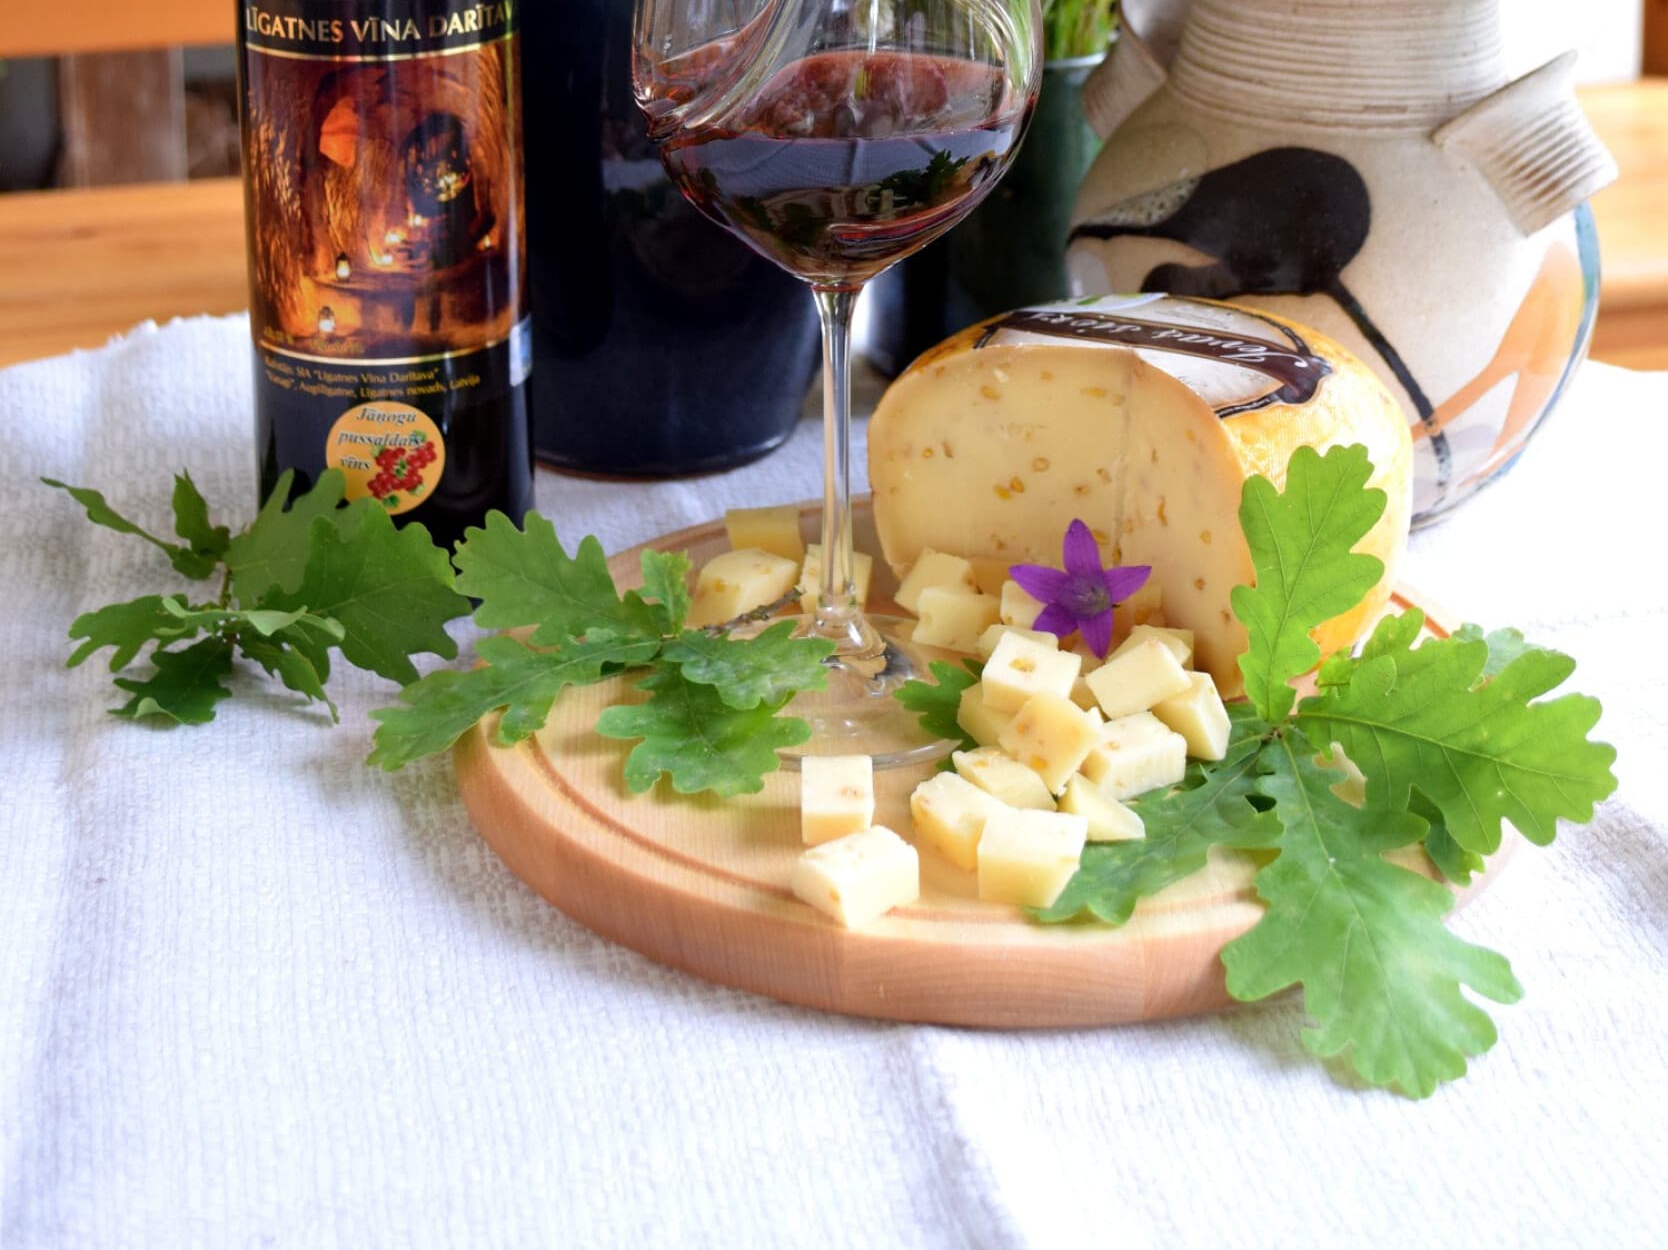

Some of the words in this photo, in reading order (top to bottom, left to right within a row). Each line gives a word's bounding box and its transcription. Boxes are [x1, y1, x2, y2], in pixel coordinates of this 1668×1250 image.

[246, 7, 344, 43] LĪGATNES
[350, 16, 421, 43] VĪNA
[339, 454, 371, 472] vīns
